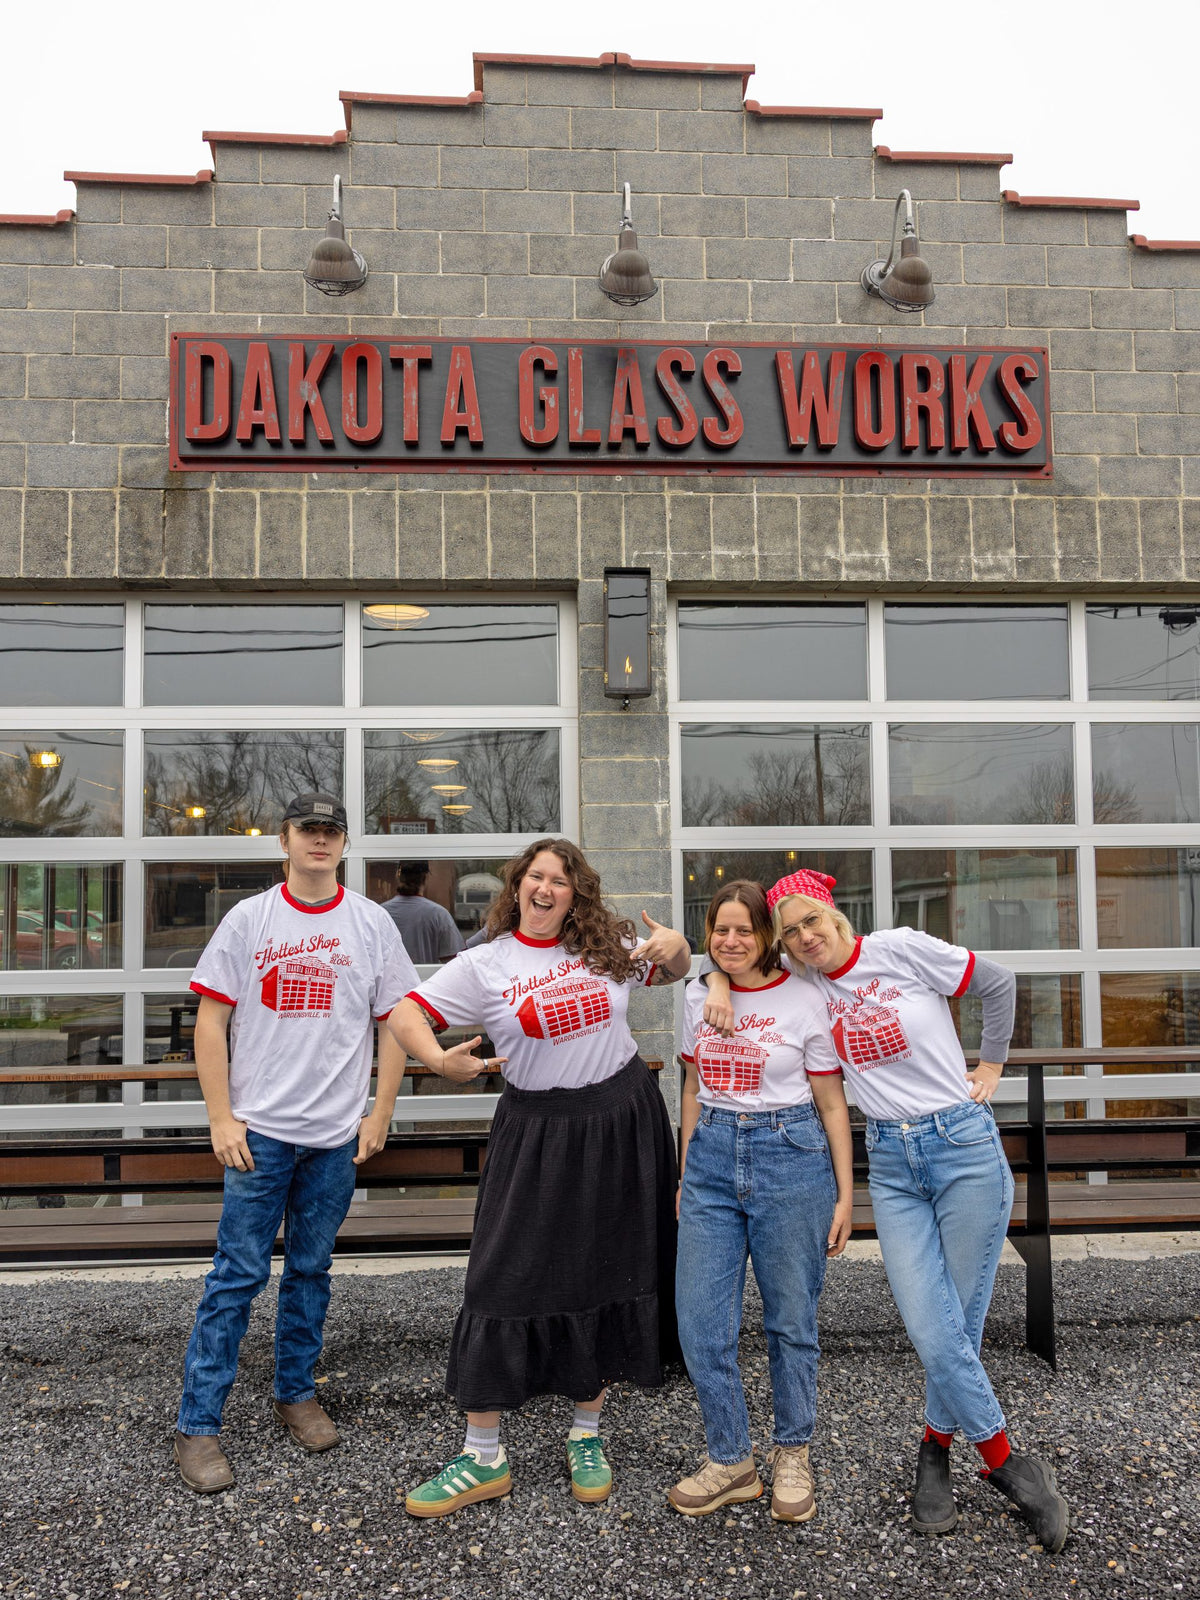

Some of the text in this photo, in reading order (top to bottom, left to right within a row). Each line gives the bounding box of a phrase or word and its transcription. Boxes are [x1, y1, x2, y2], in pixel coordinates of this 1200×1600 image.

[185, 341, 1043, 453] DAKOTA GLASS WORKS
[255, 933, 341, 970] Hottest Shop
[502, 969, 557, 1006] Hottest
[509, 975, 519, 984] THE
[543, 988, 565, 999] DAKOTA
[565, 984, 581, 995] GLASS
[734, 1013, 776, 1032] Shop
[553, 1021, 612, 1046] WARDENSVILLE, WV
[707, 1043, 760, 1058] DAKOTA GLASS WORKS
[902, 1050, 913, 1060] WV
